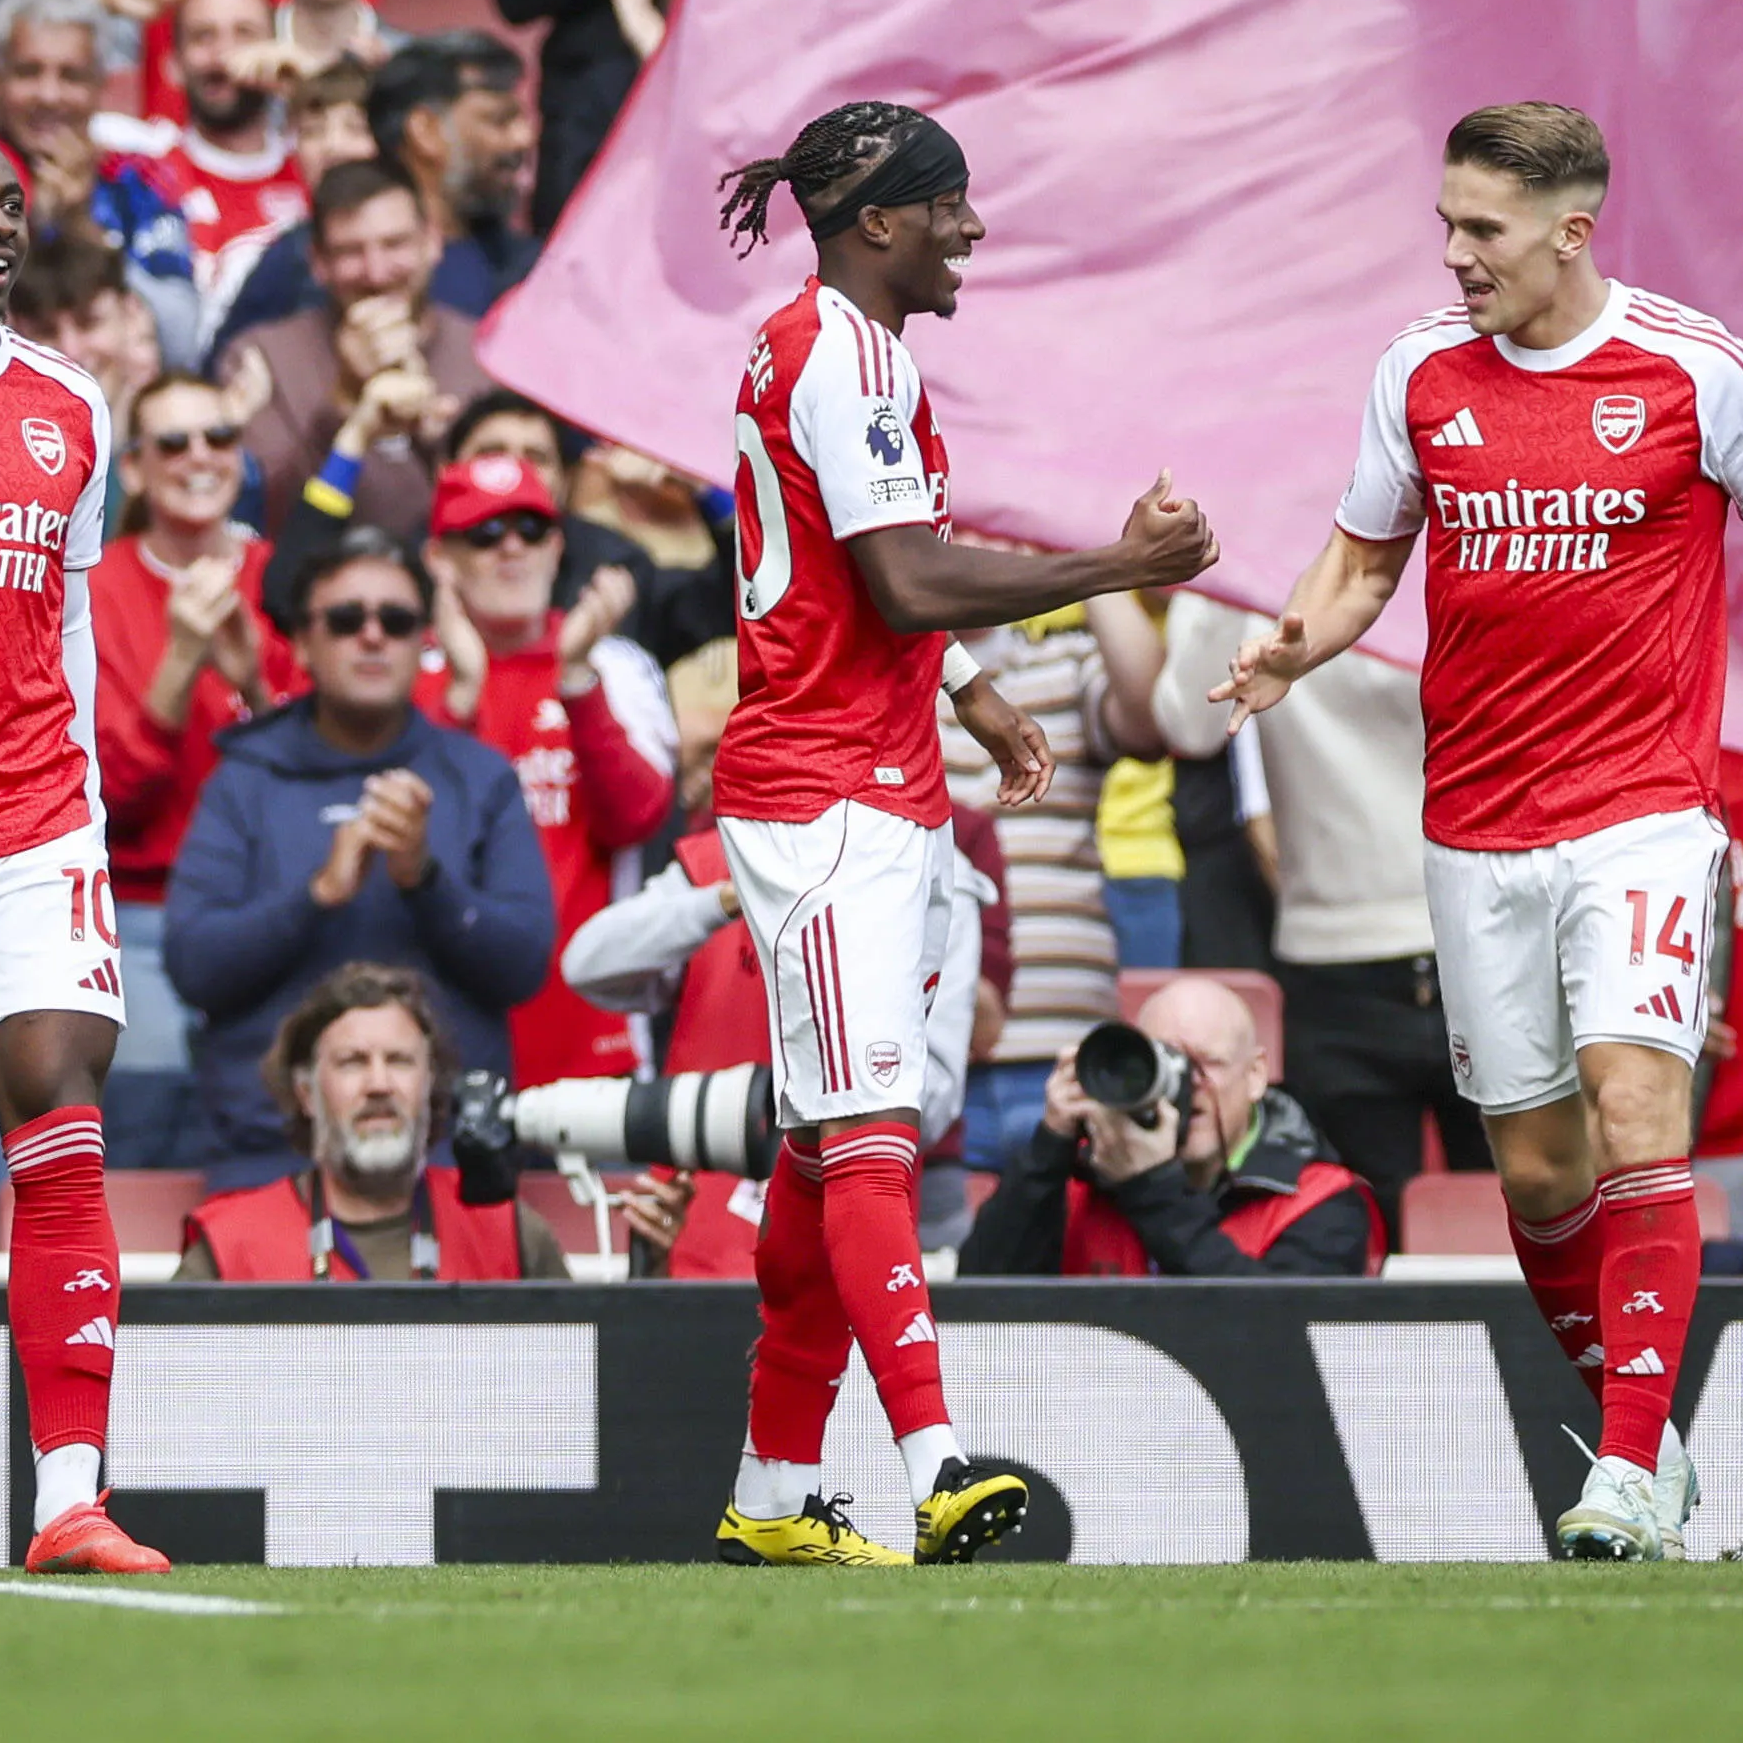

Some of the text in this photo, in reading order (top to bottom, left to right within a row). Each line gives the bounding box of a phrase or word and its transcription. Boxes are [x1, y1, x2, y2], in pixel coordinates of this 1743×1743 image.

[1433, 479, 1646, 529] Emirates
[1459, 532, 1610, 572] FLY BETTER
[61, 867, 121, 949] 10
[1626, 890, 1695, 977] 14
